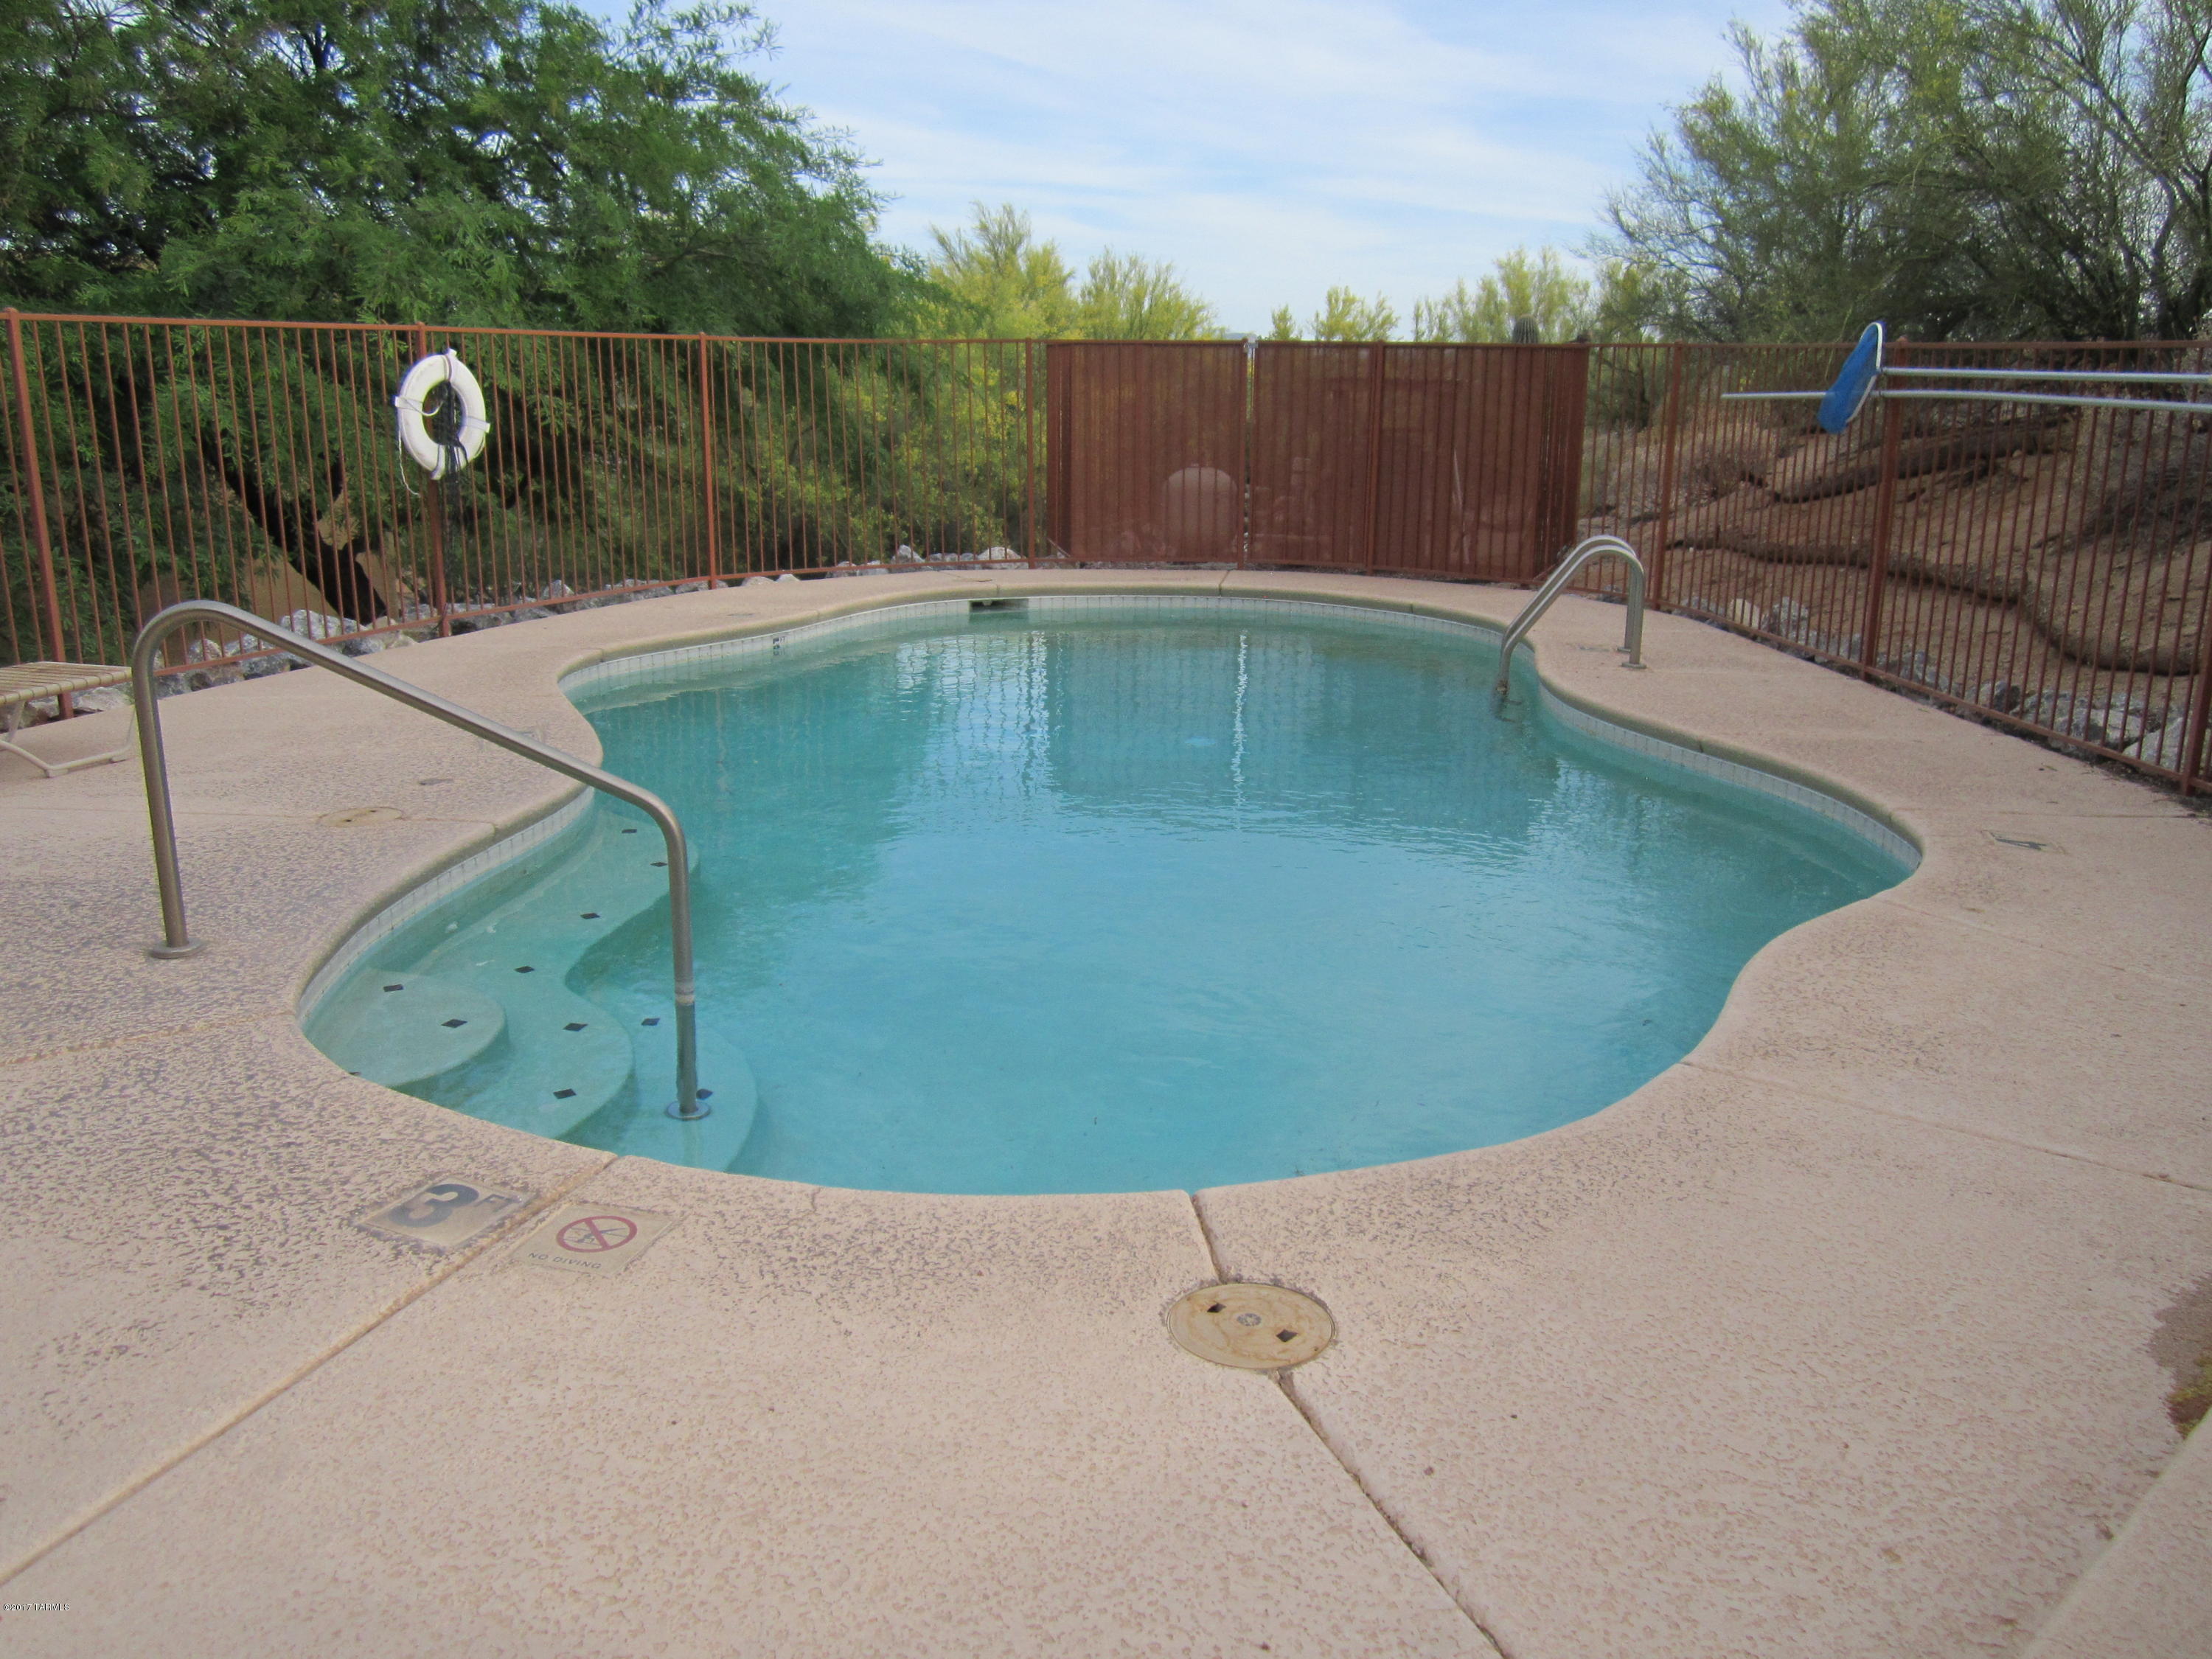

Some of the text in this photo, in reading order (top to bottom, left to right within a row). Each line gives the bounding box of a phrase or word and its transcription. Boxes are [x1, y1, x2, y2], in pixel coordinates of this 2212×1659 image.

[387, 1183, 479, 1227] 3
[528, 1252, 602, 1269] NO DIVING
